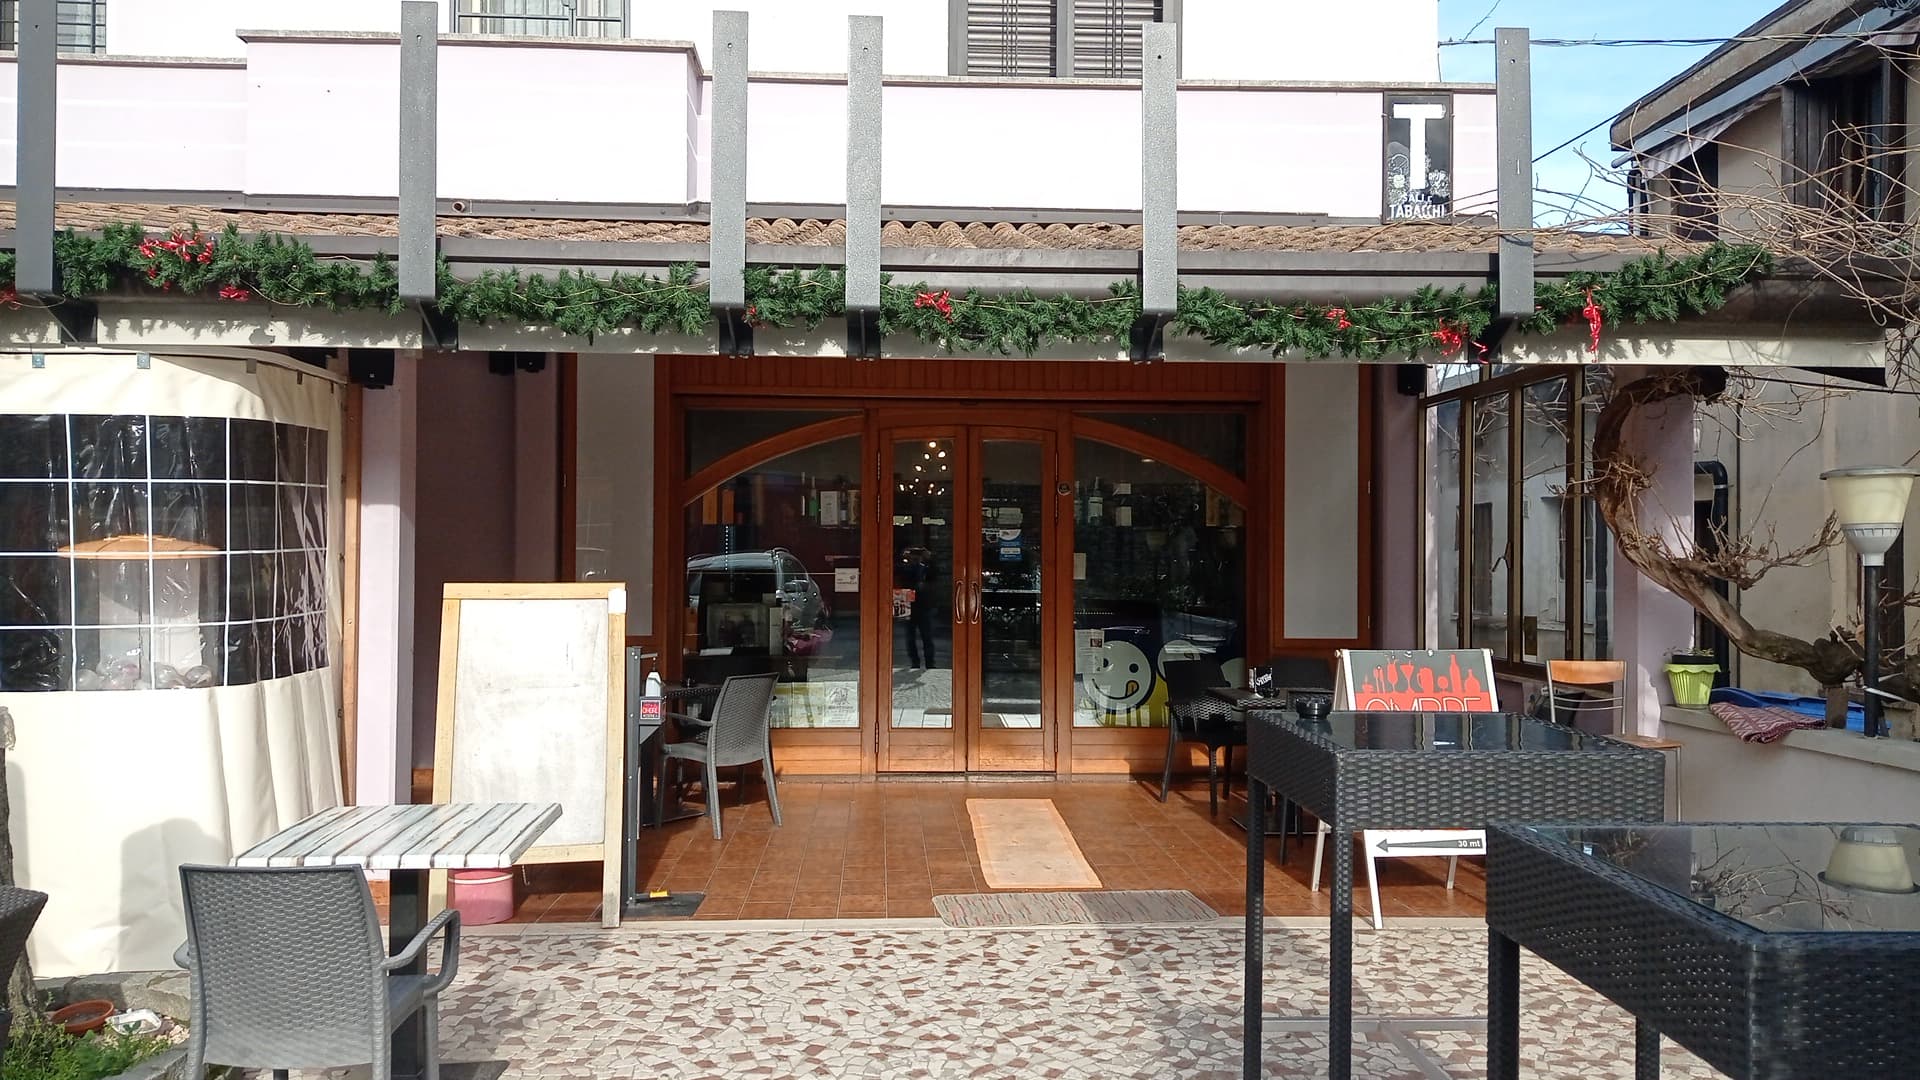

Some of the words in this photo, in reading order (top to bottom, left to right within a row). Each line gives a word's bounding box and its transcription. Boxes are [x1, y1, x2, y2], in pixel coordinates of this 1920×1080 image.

[1393, 103, 1445, 190] T
[1389, 204, 1445, 219] TABACCHI
[1458, 840, 1468, 848] 30
[1469, 840, 1481, 848] mt
